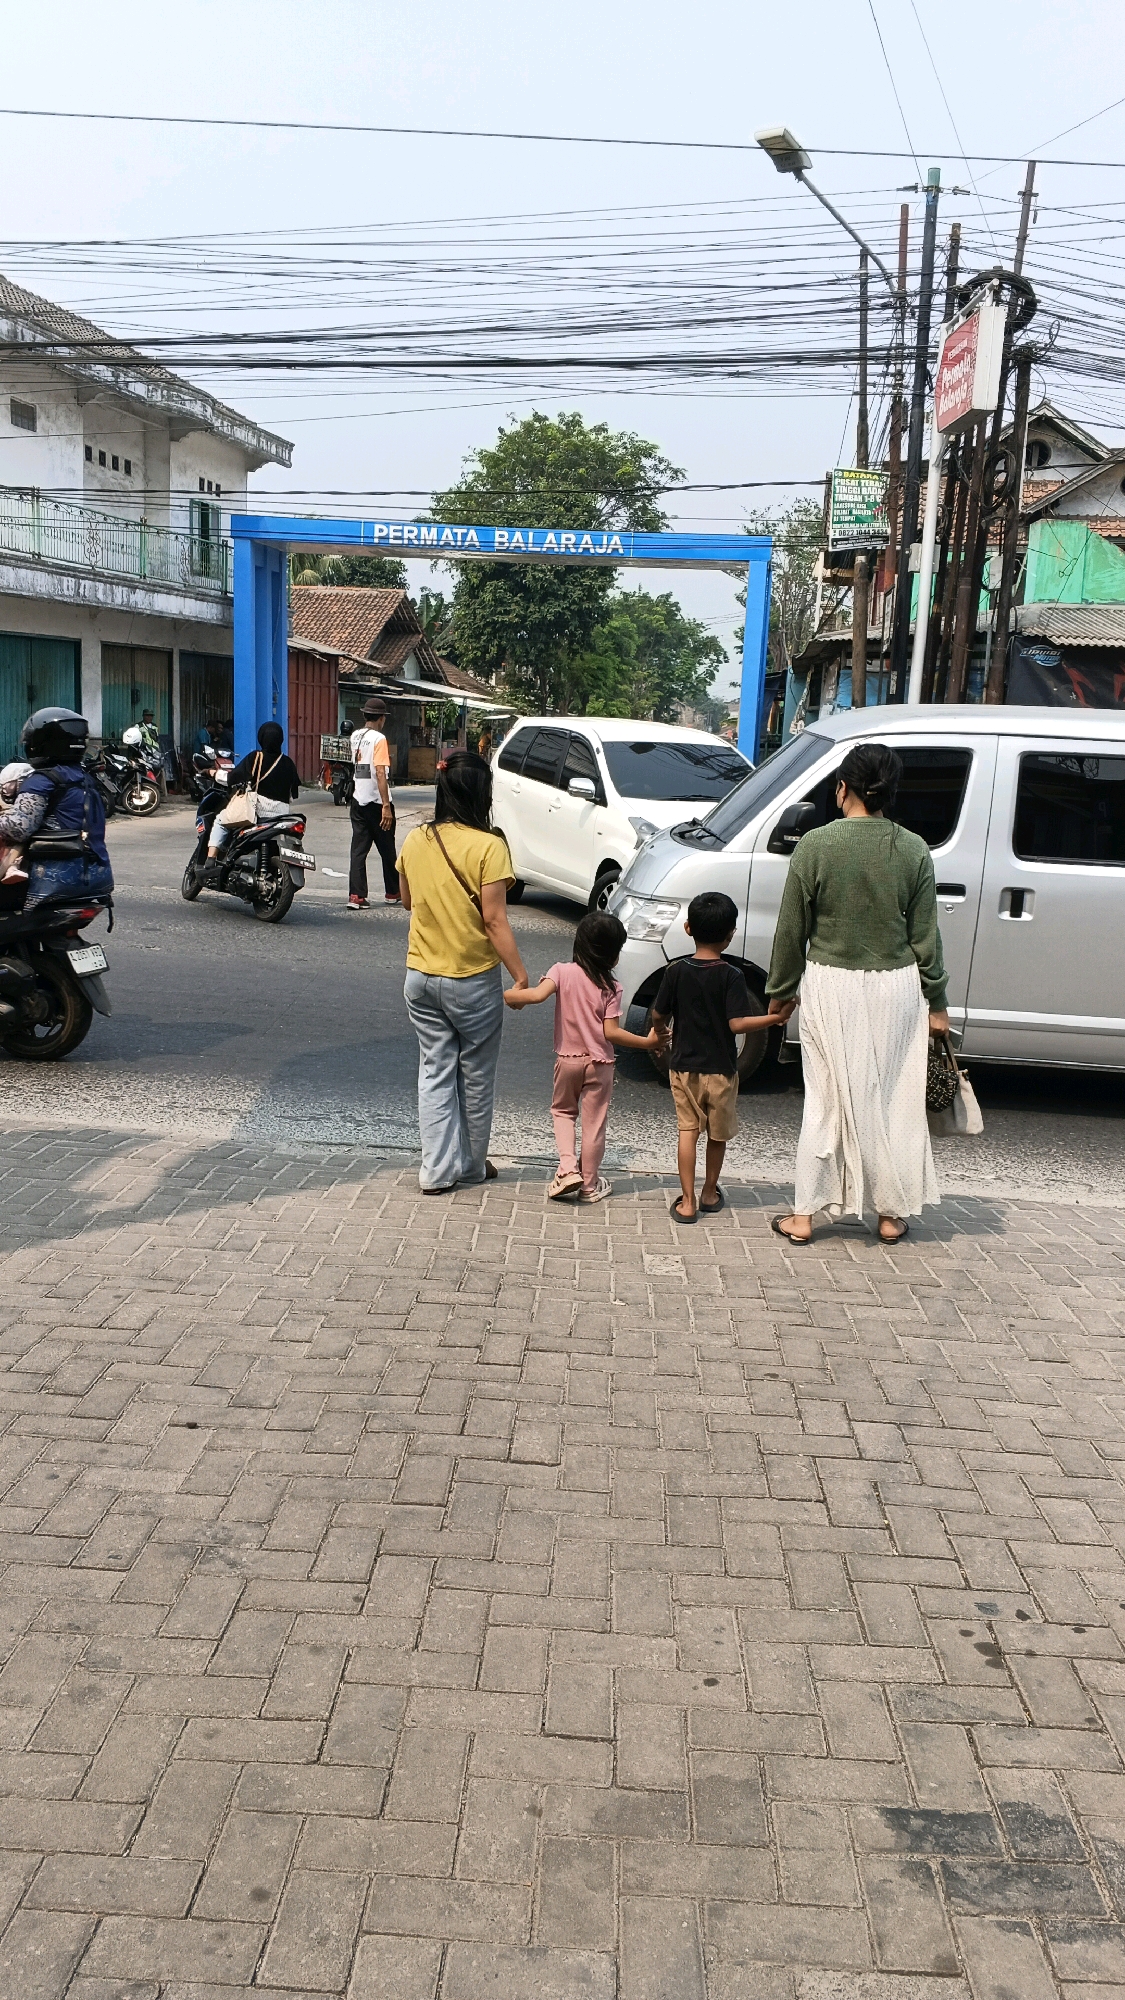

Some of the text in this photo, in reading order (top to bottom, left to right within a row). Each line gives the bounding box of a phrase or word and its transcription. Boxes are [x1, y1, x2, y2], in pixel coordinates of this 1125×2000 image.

[939, 378, 968, 417] Balaraja
[835, 486, 860, 494] TINGGI
[373, 523, 625, 555] PERMATA BALARAJA
